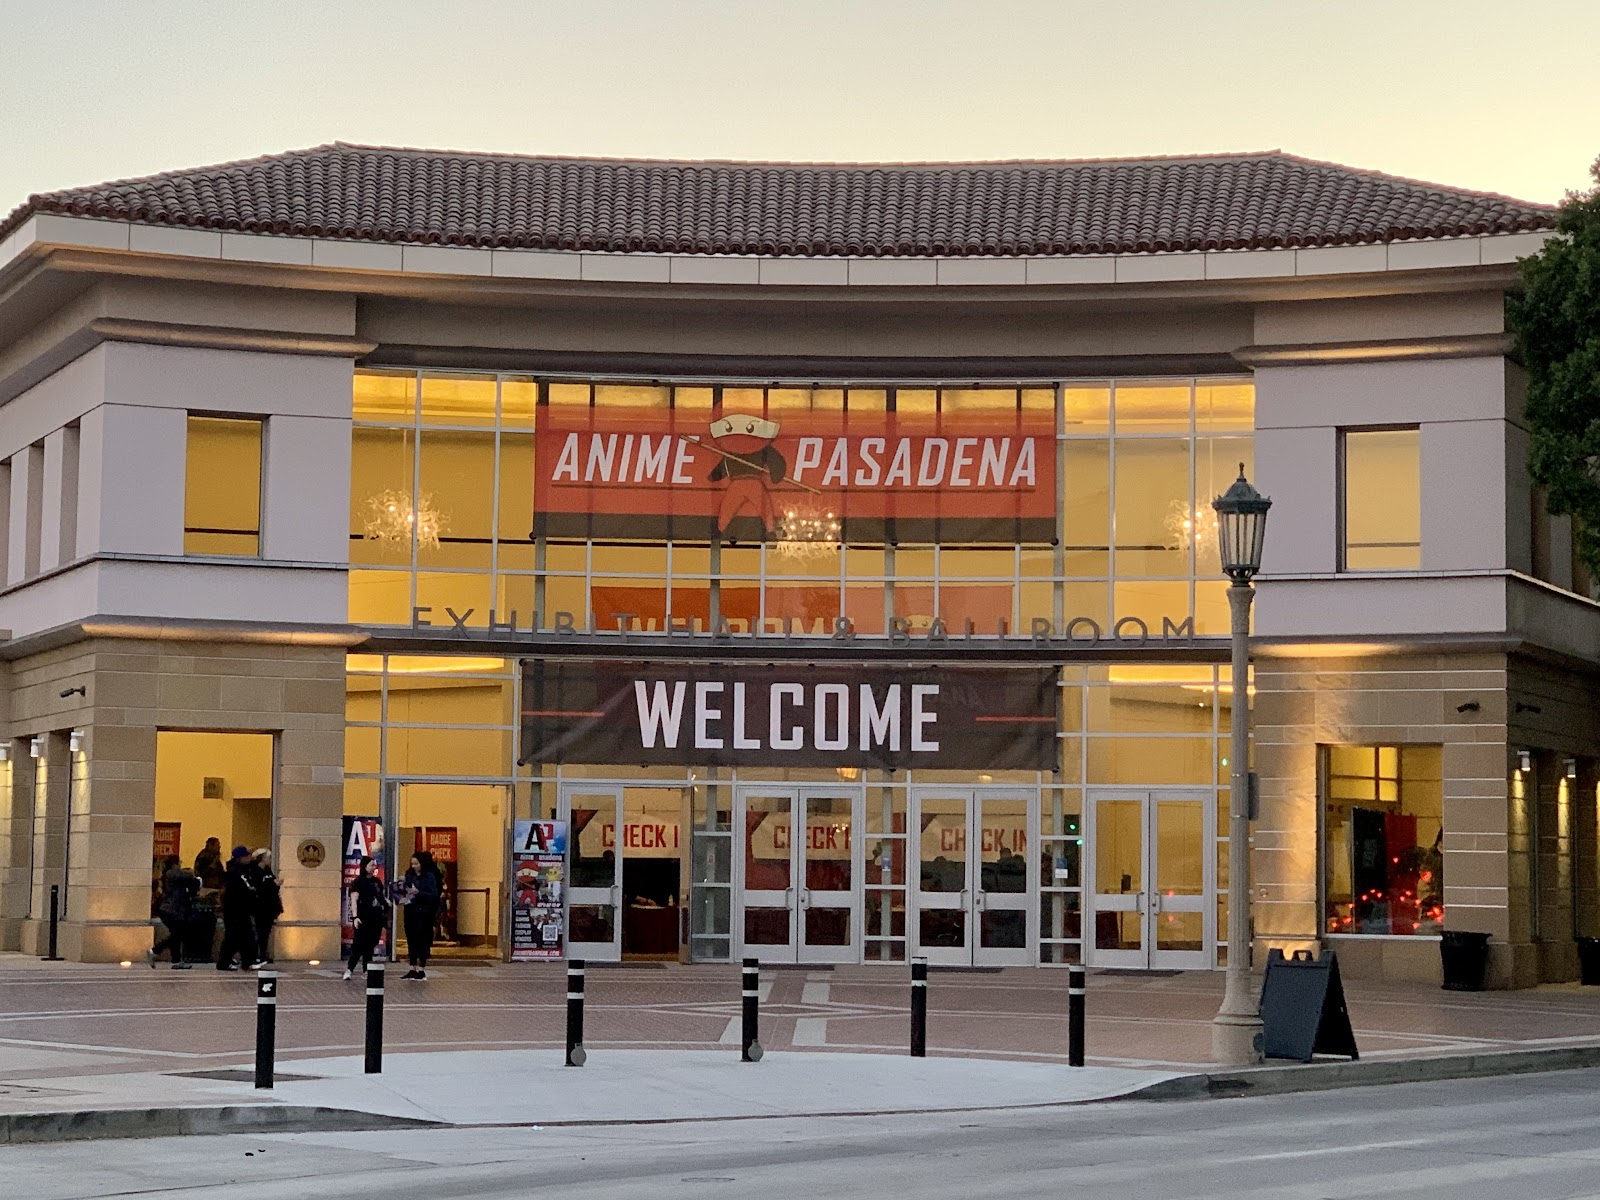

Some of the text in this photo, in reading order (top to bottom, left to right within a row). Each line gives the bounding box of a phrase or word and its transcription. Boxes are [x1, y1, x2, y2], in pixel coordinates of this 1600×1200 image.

[552, 432, 1036, 487] ANIME PASADENA
[412, 606, 638, 644] EXHIBIT
[831, 616, 857, 647] &
[888, 616, 1195, 648] BALLROOM
[634, 680, 940, 752] WELCOME
[154, 829, 175, 841] ADGE
[430, 834, 451, 846] BADGE
[773, 826, 837, 849] CCK
[940, 828, 1005, 852] CHCK
